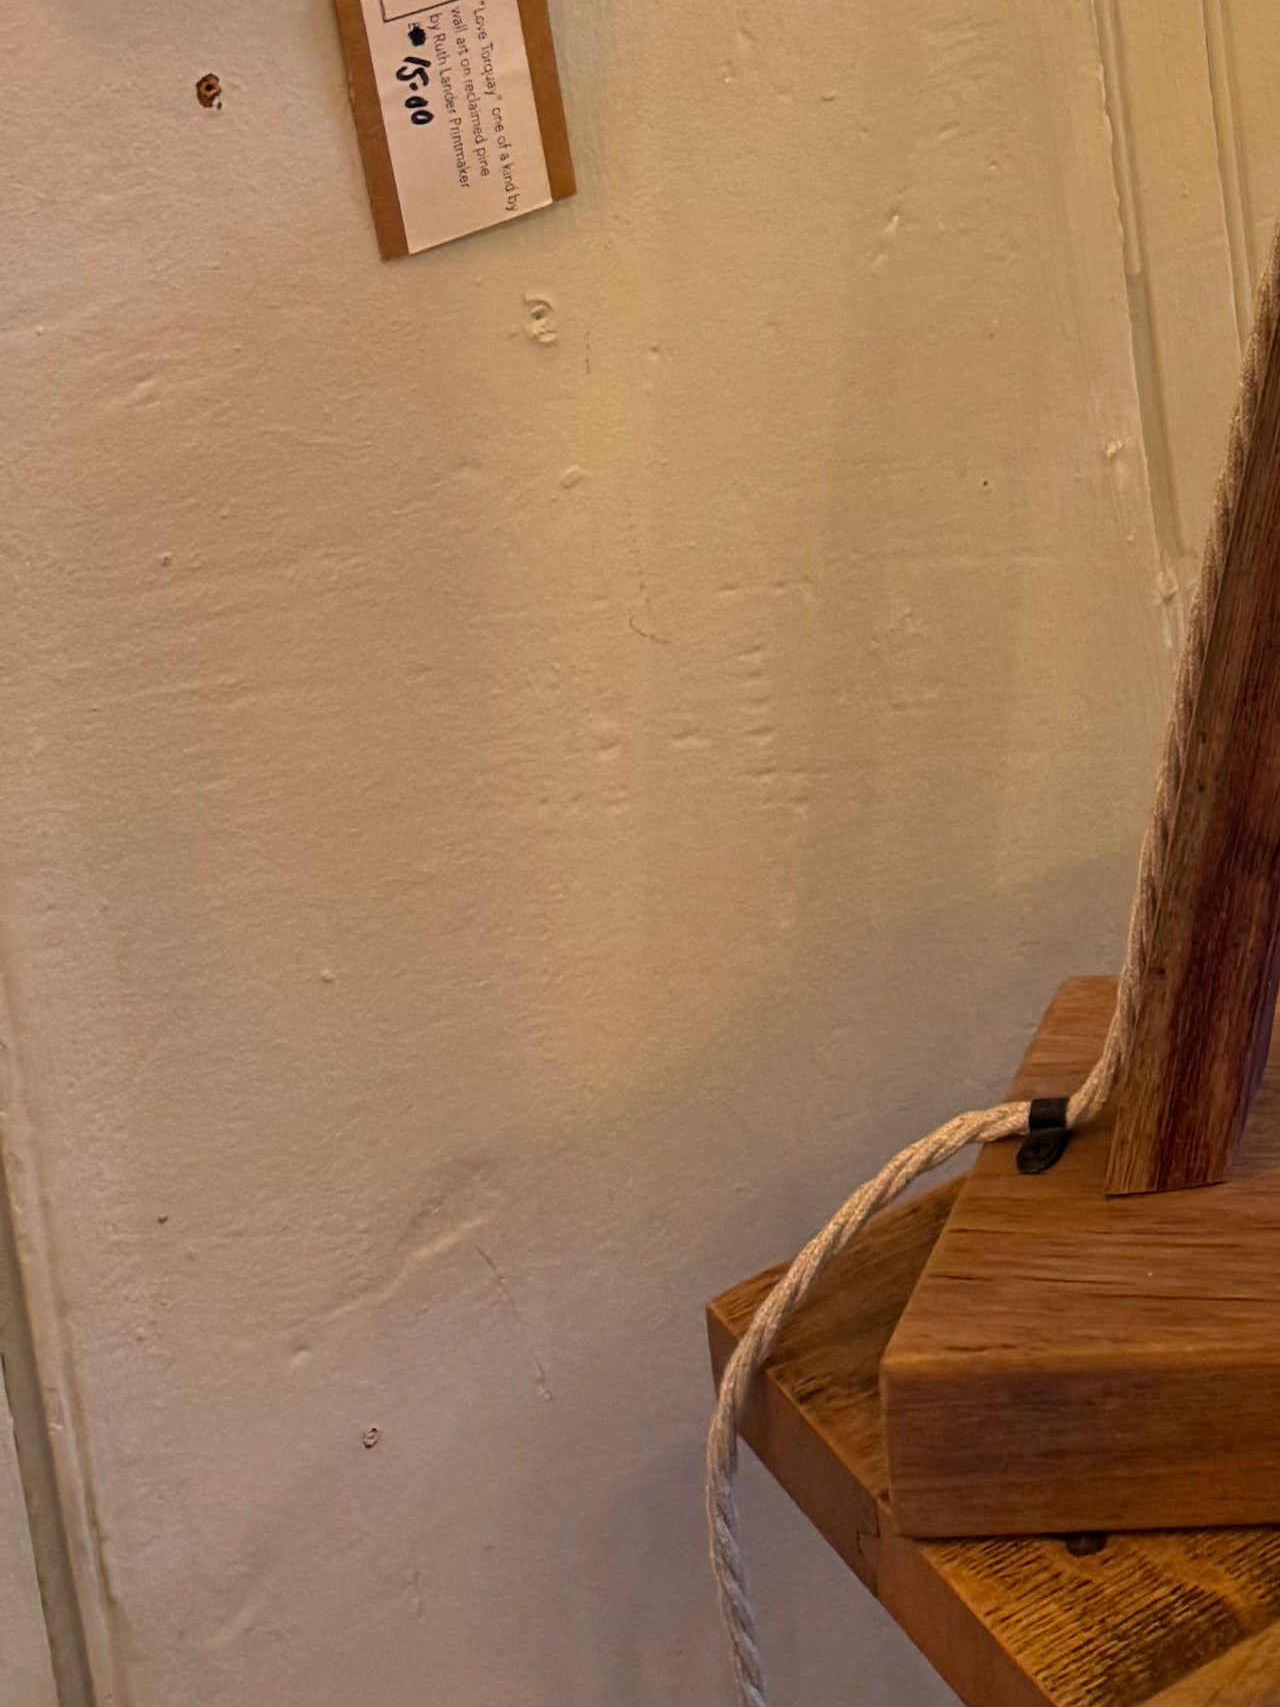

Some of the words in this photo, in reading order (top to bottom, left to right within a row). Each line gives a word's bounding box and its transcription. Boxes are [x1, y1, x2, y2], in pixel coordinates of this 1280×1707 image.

[428, 11, 444, 32] by
[451, 6, 469, 36] wall
[433, 33, 449, 68] Ruth
[456, 37, 470, 56] art
[460, 58, 472, 77] on
[439, 67, 457, 114] Lander
[464, 78, 484, 146] reclaimed
[491, 106, 505, 133] one
[449, 116, 471, 189] Printmaker
[497, 134, 512, 151] of
[473, 146, 491, 178] pine
[502, 162, 516, 193] kind
[505, 193, 521, 213] by
